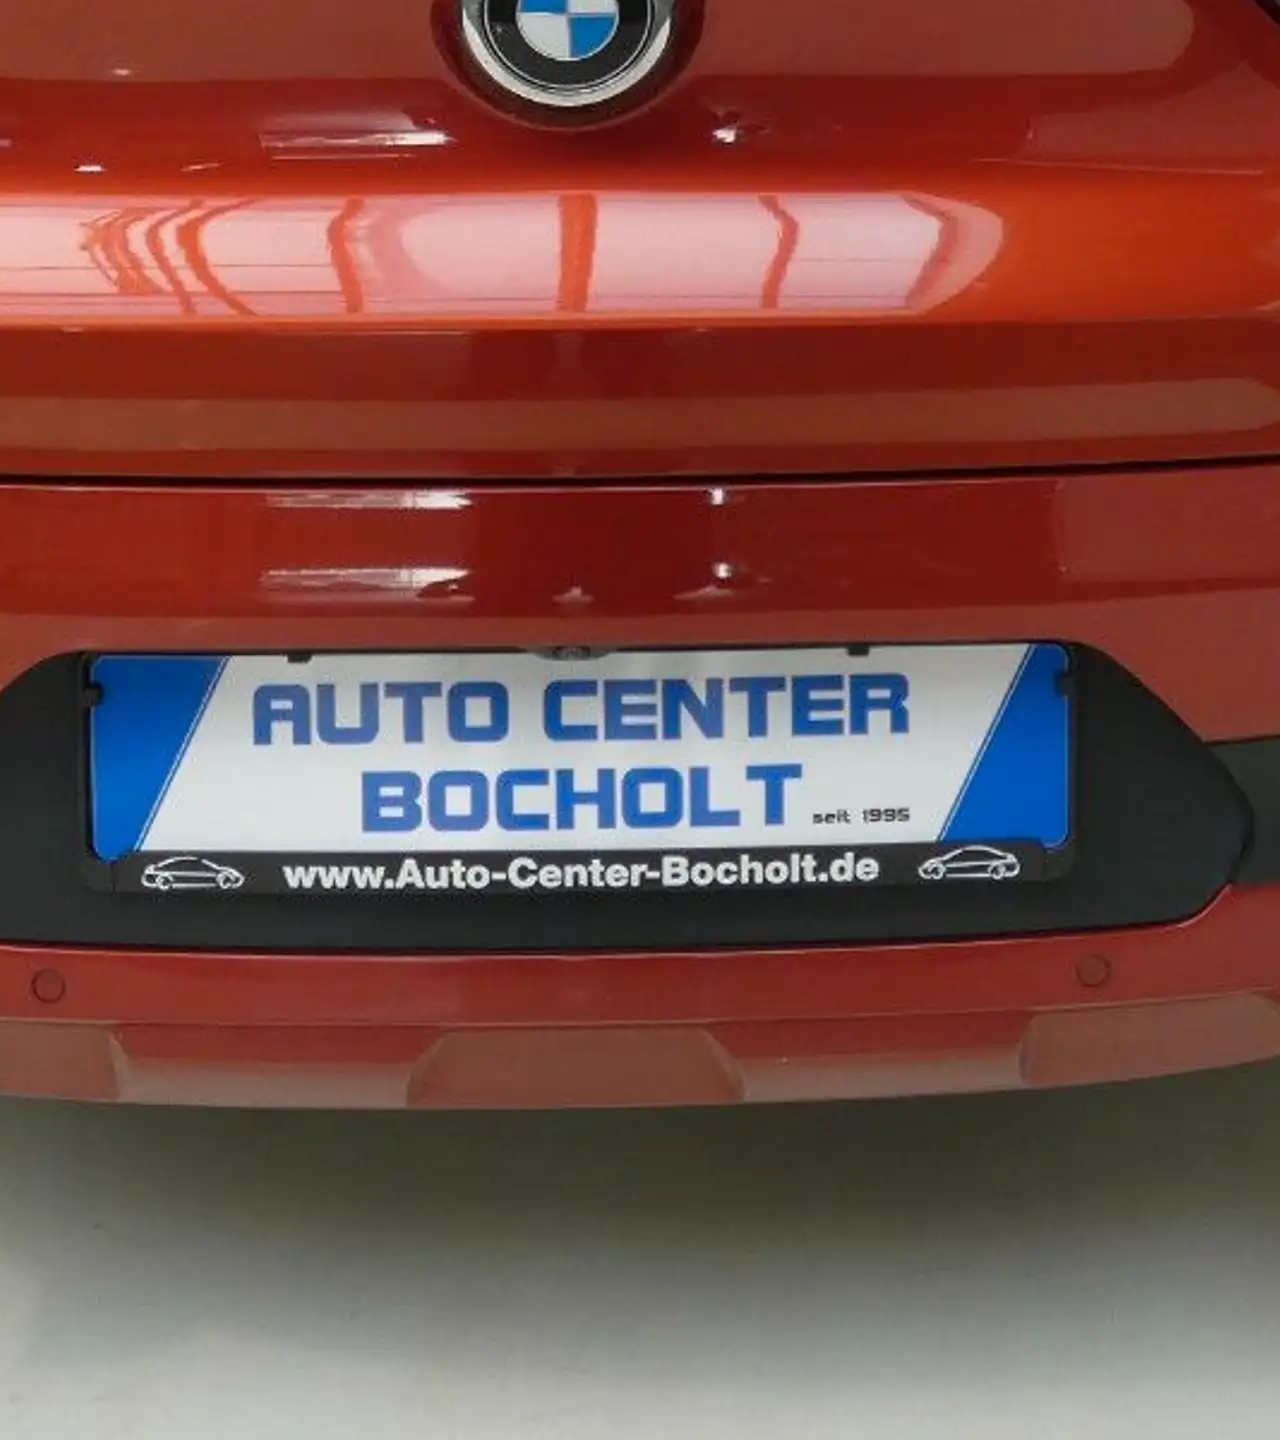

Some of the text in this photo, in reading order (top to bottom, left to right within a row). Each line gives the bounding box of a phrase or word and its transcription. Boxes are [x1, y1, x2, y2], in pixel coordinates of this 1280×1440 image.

[251, 672, 911, 745] AUTO CENTER
[360, 762, 910, 834] BOCHOLT seit 1995
[282, 852, 880, 890] www.Auto-Center-Bocholt.de
